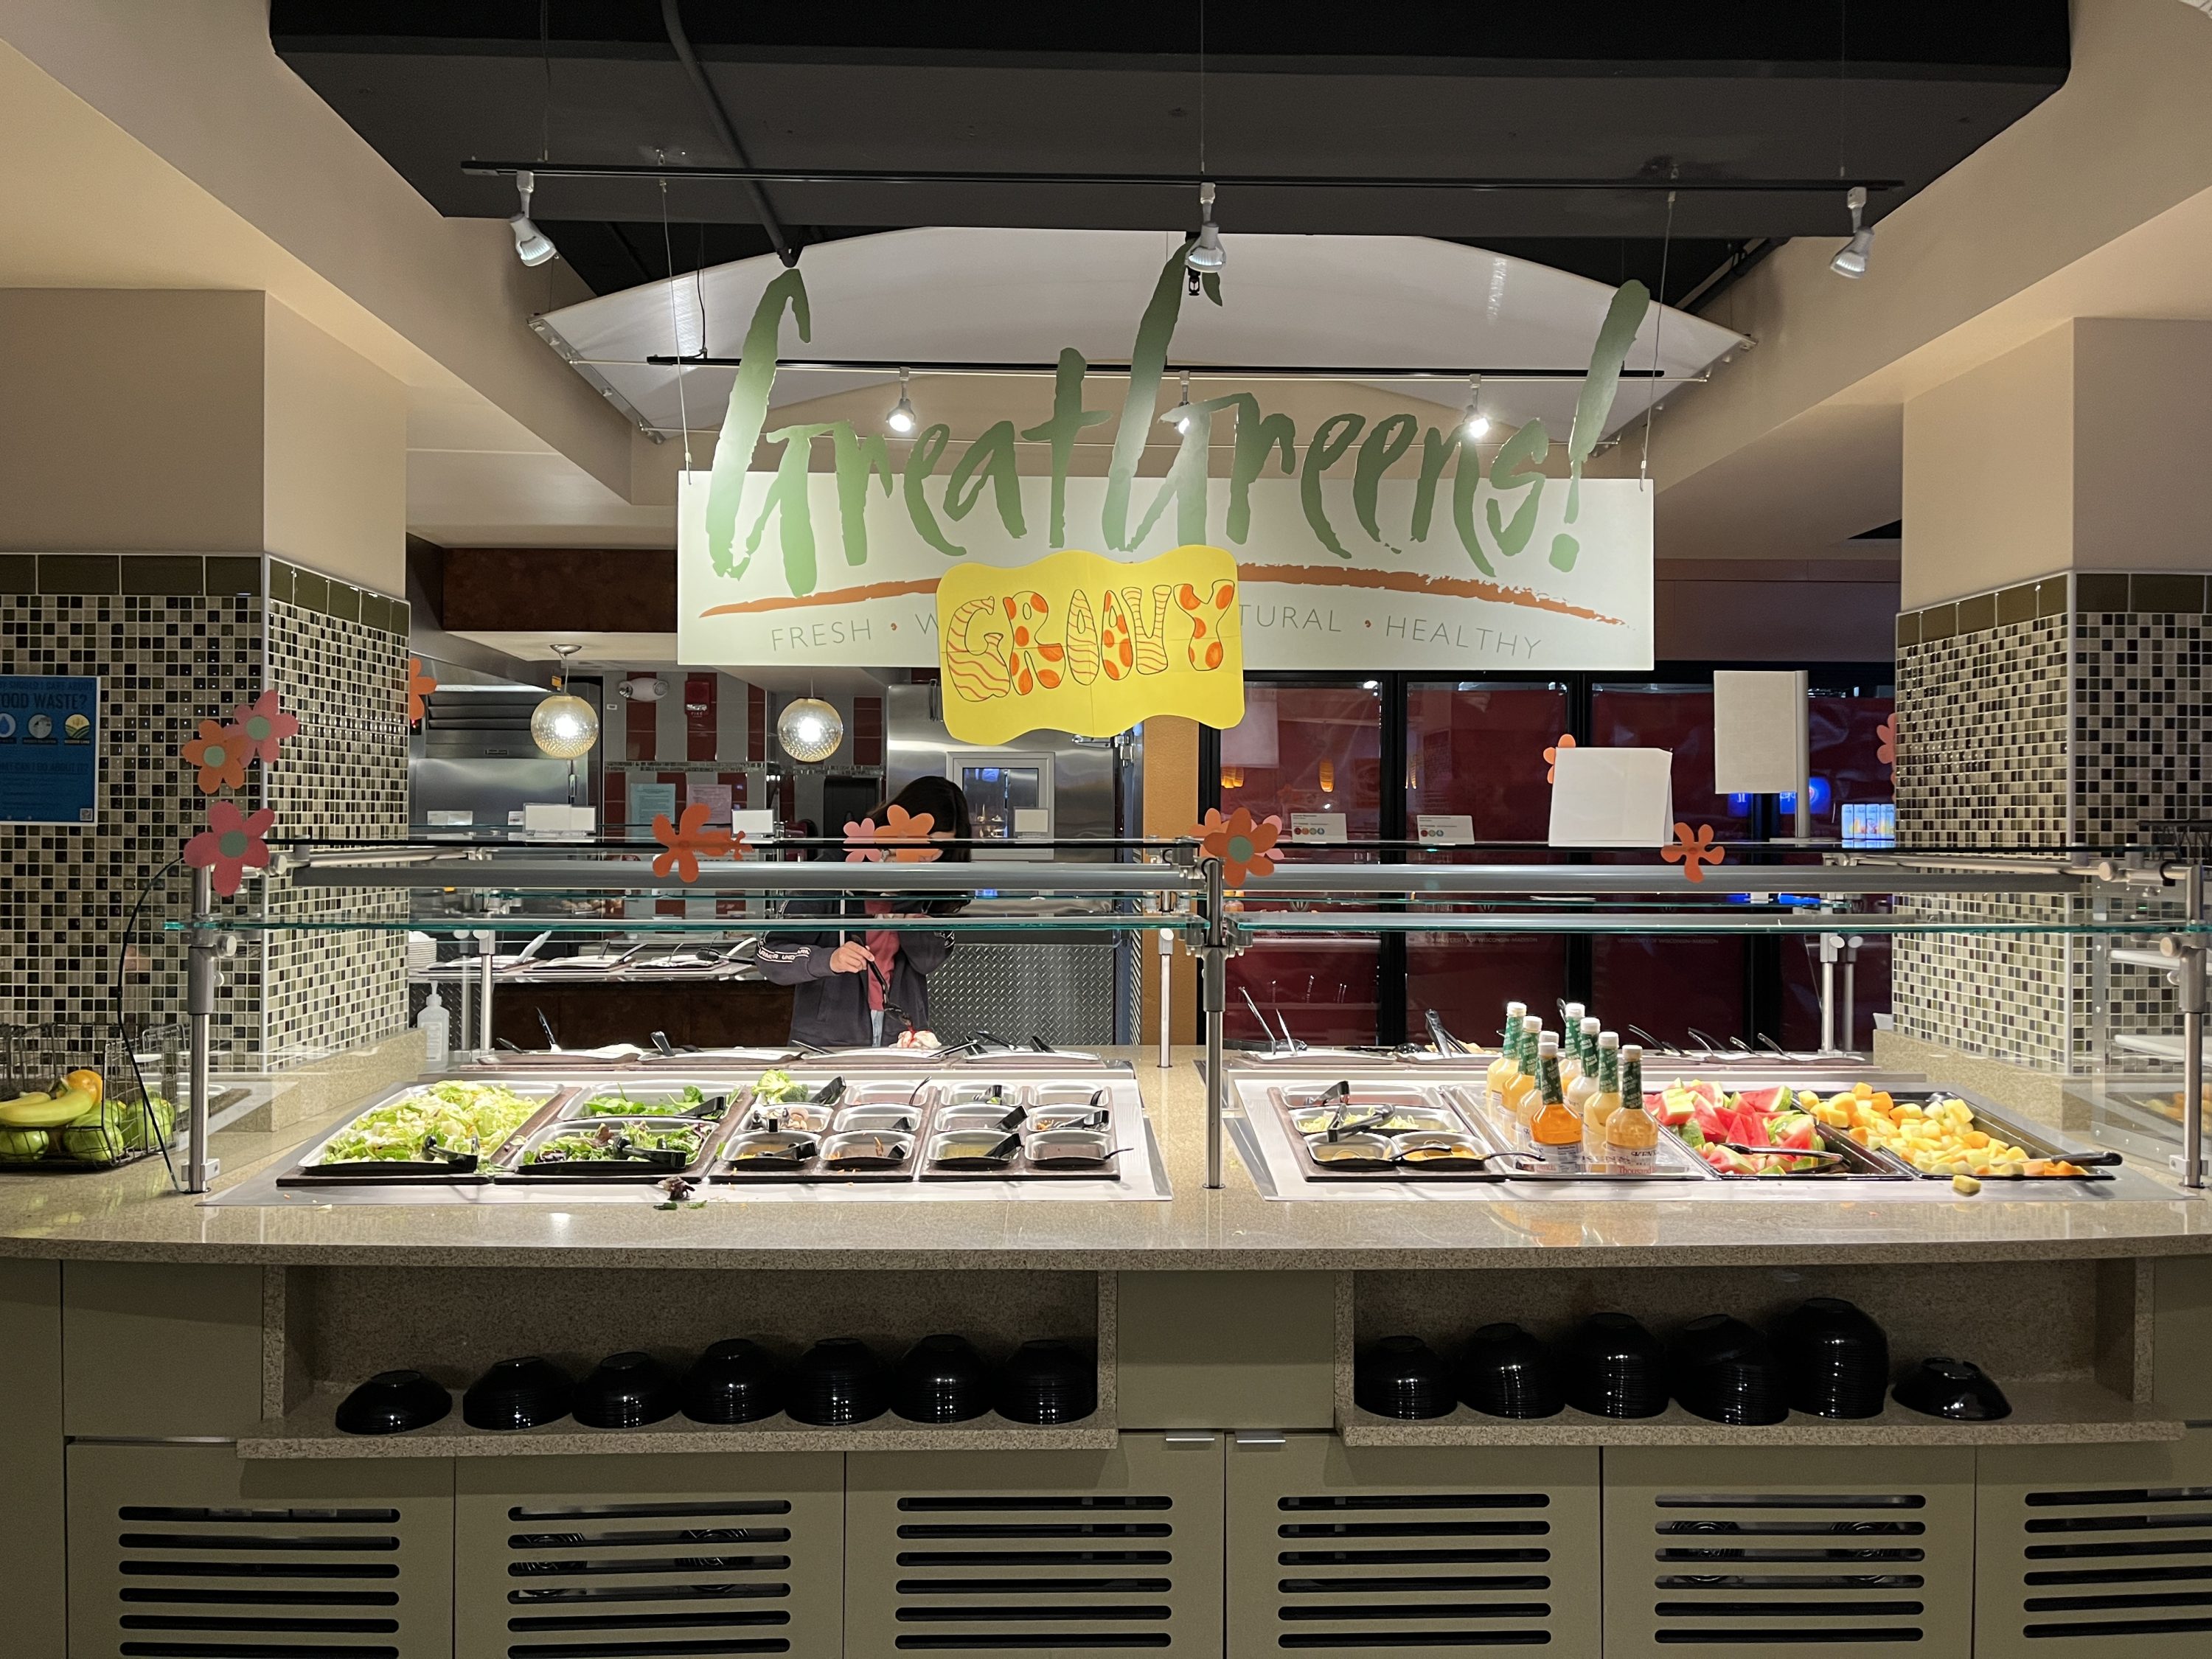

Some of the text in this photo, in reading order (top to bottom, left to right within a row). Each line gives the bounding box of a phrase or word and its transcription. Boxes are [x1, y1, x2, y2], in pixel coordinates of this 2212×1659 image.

[706, 238, 1651, 598] Great Greens!
[771, 618, 872, 652] FRESH
[946, 579, 1235, 703] GROOVY
[1239, 604, 1541, 660] TURAL HEALTHY
[0, 692, 88, 710] OOD WASTE?
